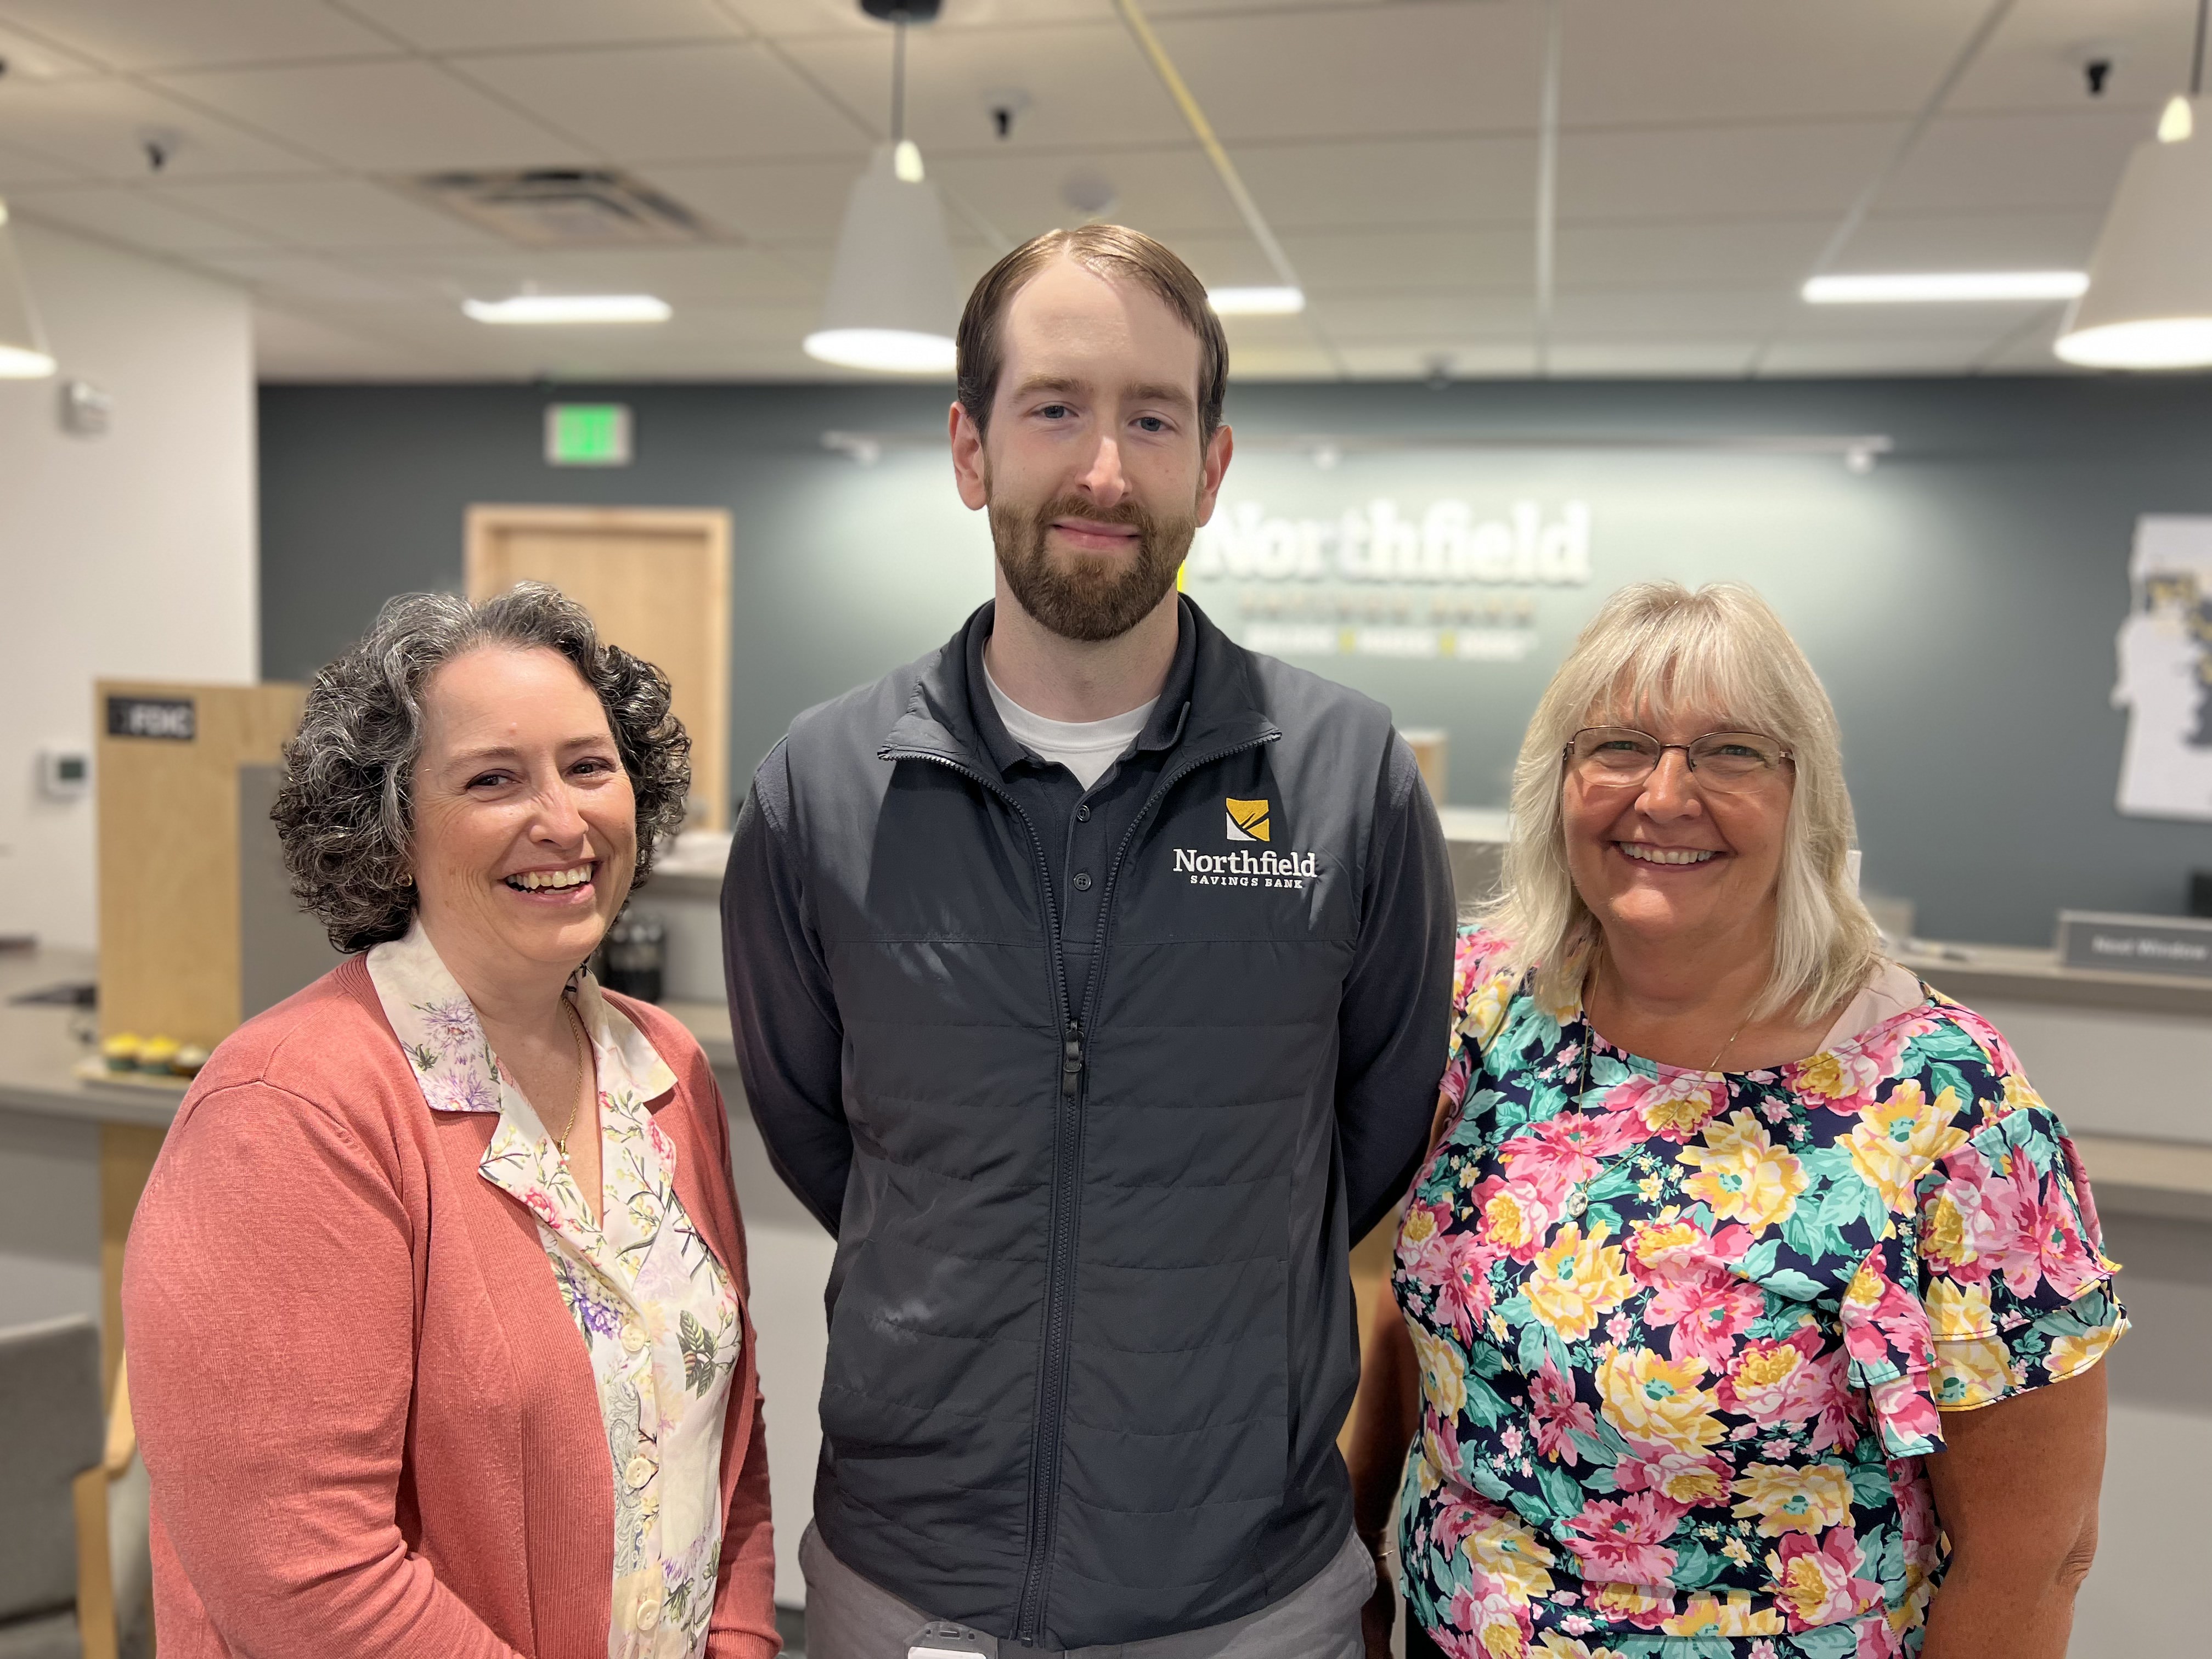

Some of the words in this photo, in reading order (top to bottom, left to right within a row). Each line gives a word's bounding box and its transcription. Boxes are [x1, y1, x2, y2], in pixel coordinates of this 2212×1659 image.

[1198, 500, 1591, 584] Northfield
[1173, 849, 1318, 878] Northfield
[1190, 875, 1259, 887] SAVINGS
[1265, 878, 1303, 889] BANK
